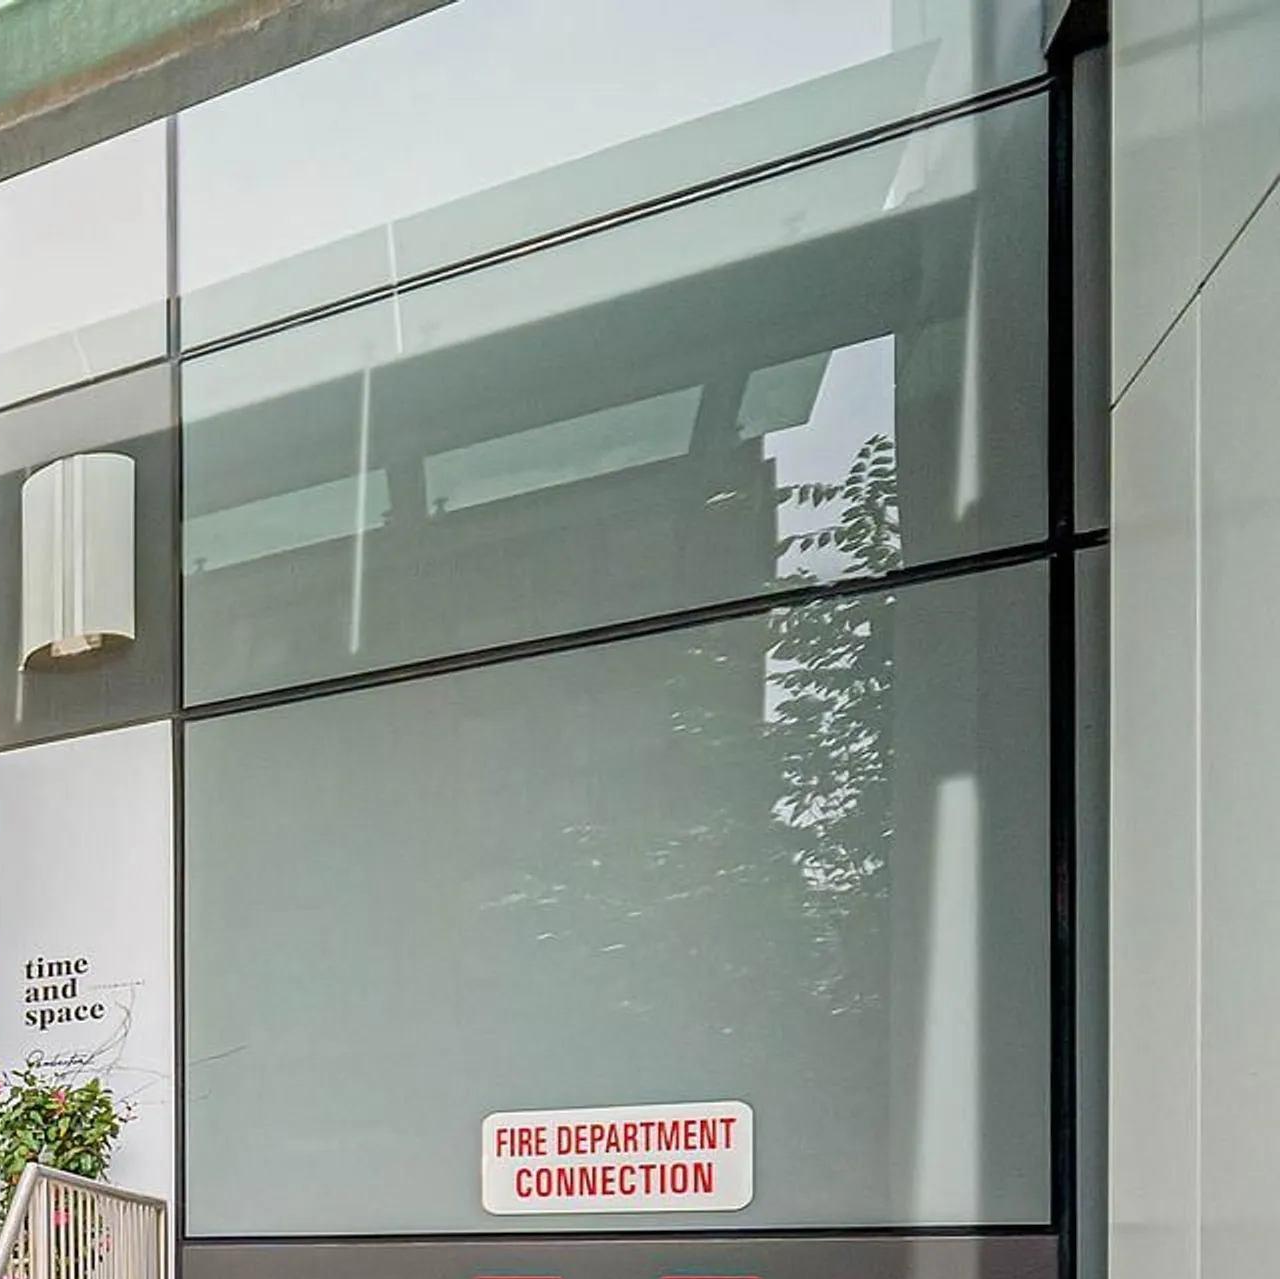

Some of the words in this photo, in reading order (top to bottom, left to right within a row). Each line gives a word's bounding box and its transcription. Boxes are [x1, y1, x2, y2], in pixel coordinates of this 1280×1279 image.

[25, 957, 89, 980] time
[25, 978, 78, 1003] and
[25, 1003, 105, 1031] space
[496, 1126, 547, 1157] FIRE
[557, 1118, 737, 1155] DEPARTMENT
[515, 1162, 714, 1198] CONNECTION
